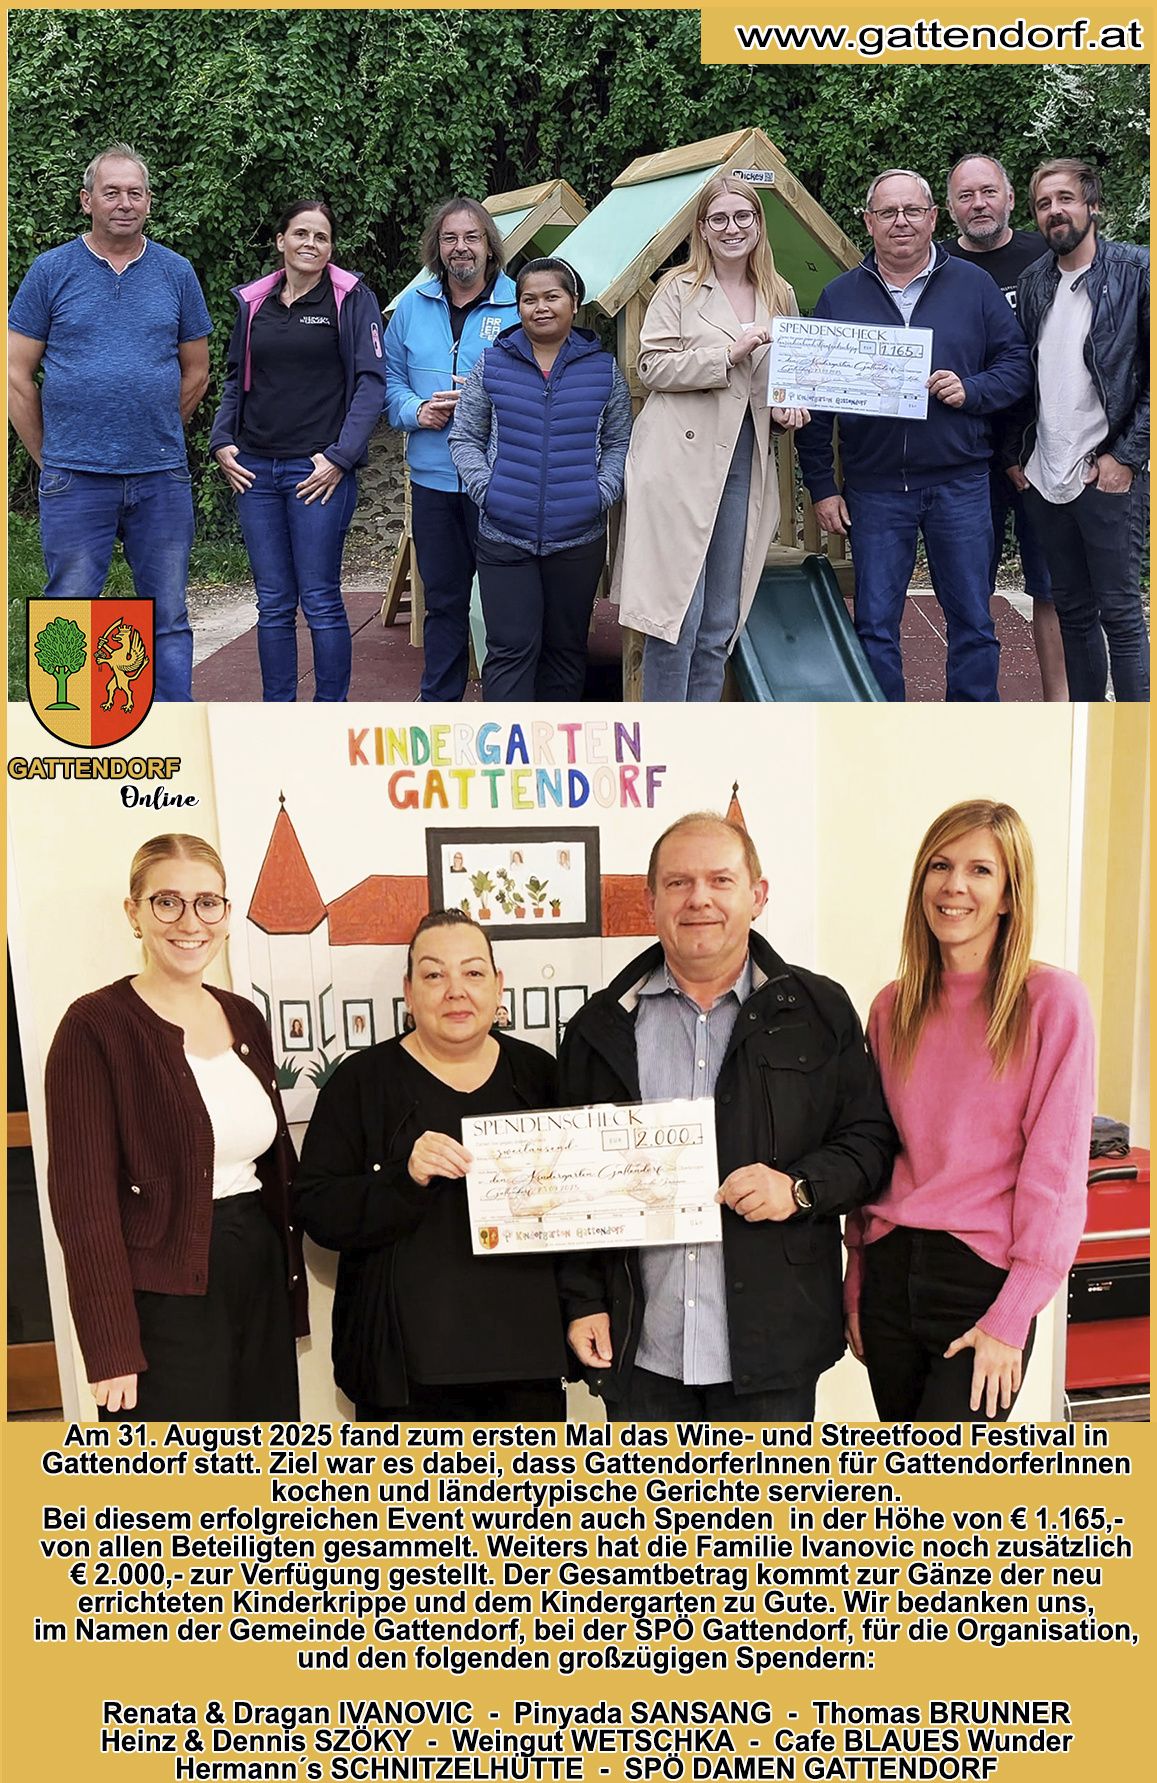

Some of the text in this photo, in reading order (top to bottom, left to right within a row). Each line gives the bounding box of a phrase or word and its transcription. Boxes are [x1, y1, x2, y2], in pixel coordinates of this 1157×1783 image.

[779, 322, 888, 341] SPENDENSCHECK
[348, 720, 642, 766] KINDERGARTEN
[388, 765, 667, 809] GATTENDORF
[473, 1109, 643, 1136] SPENDENSCHECK
